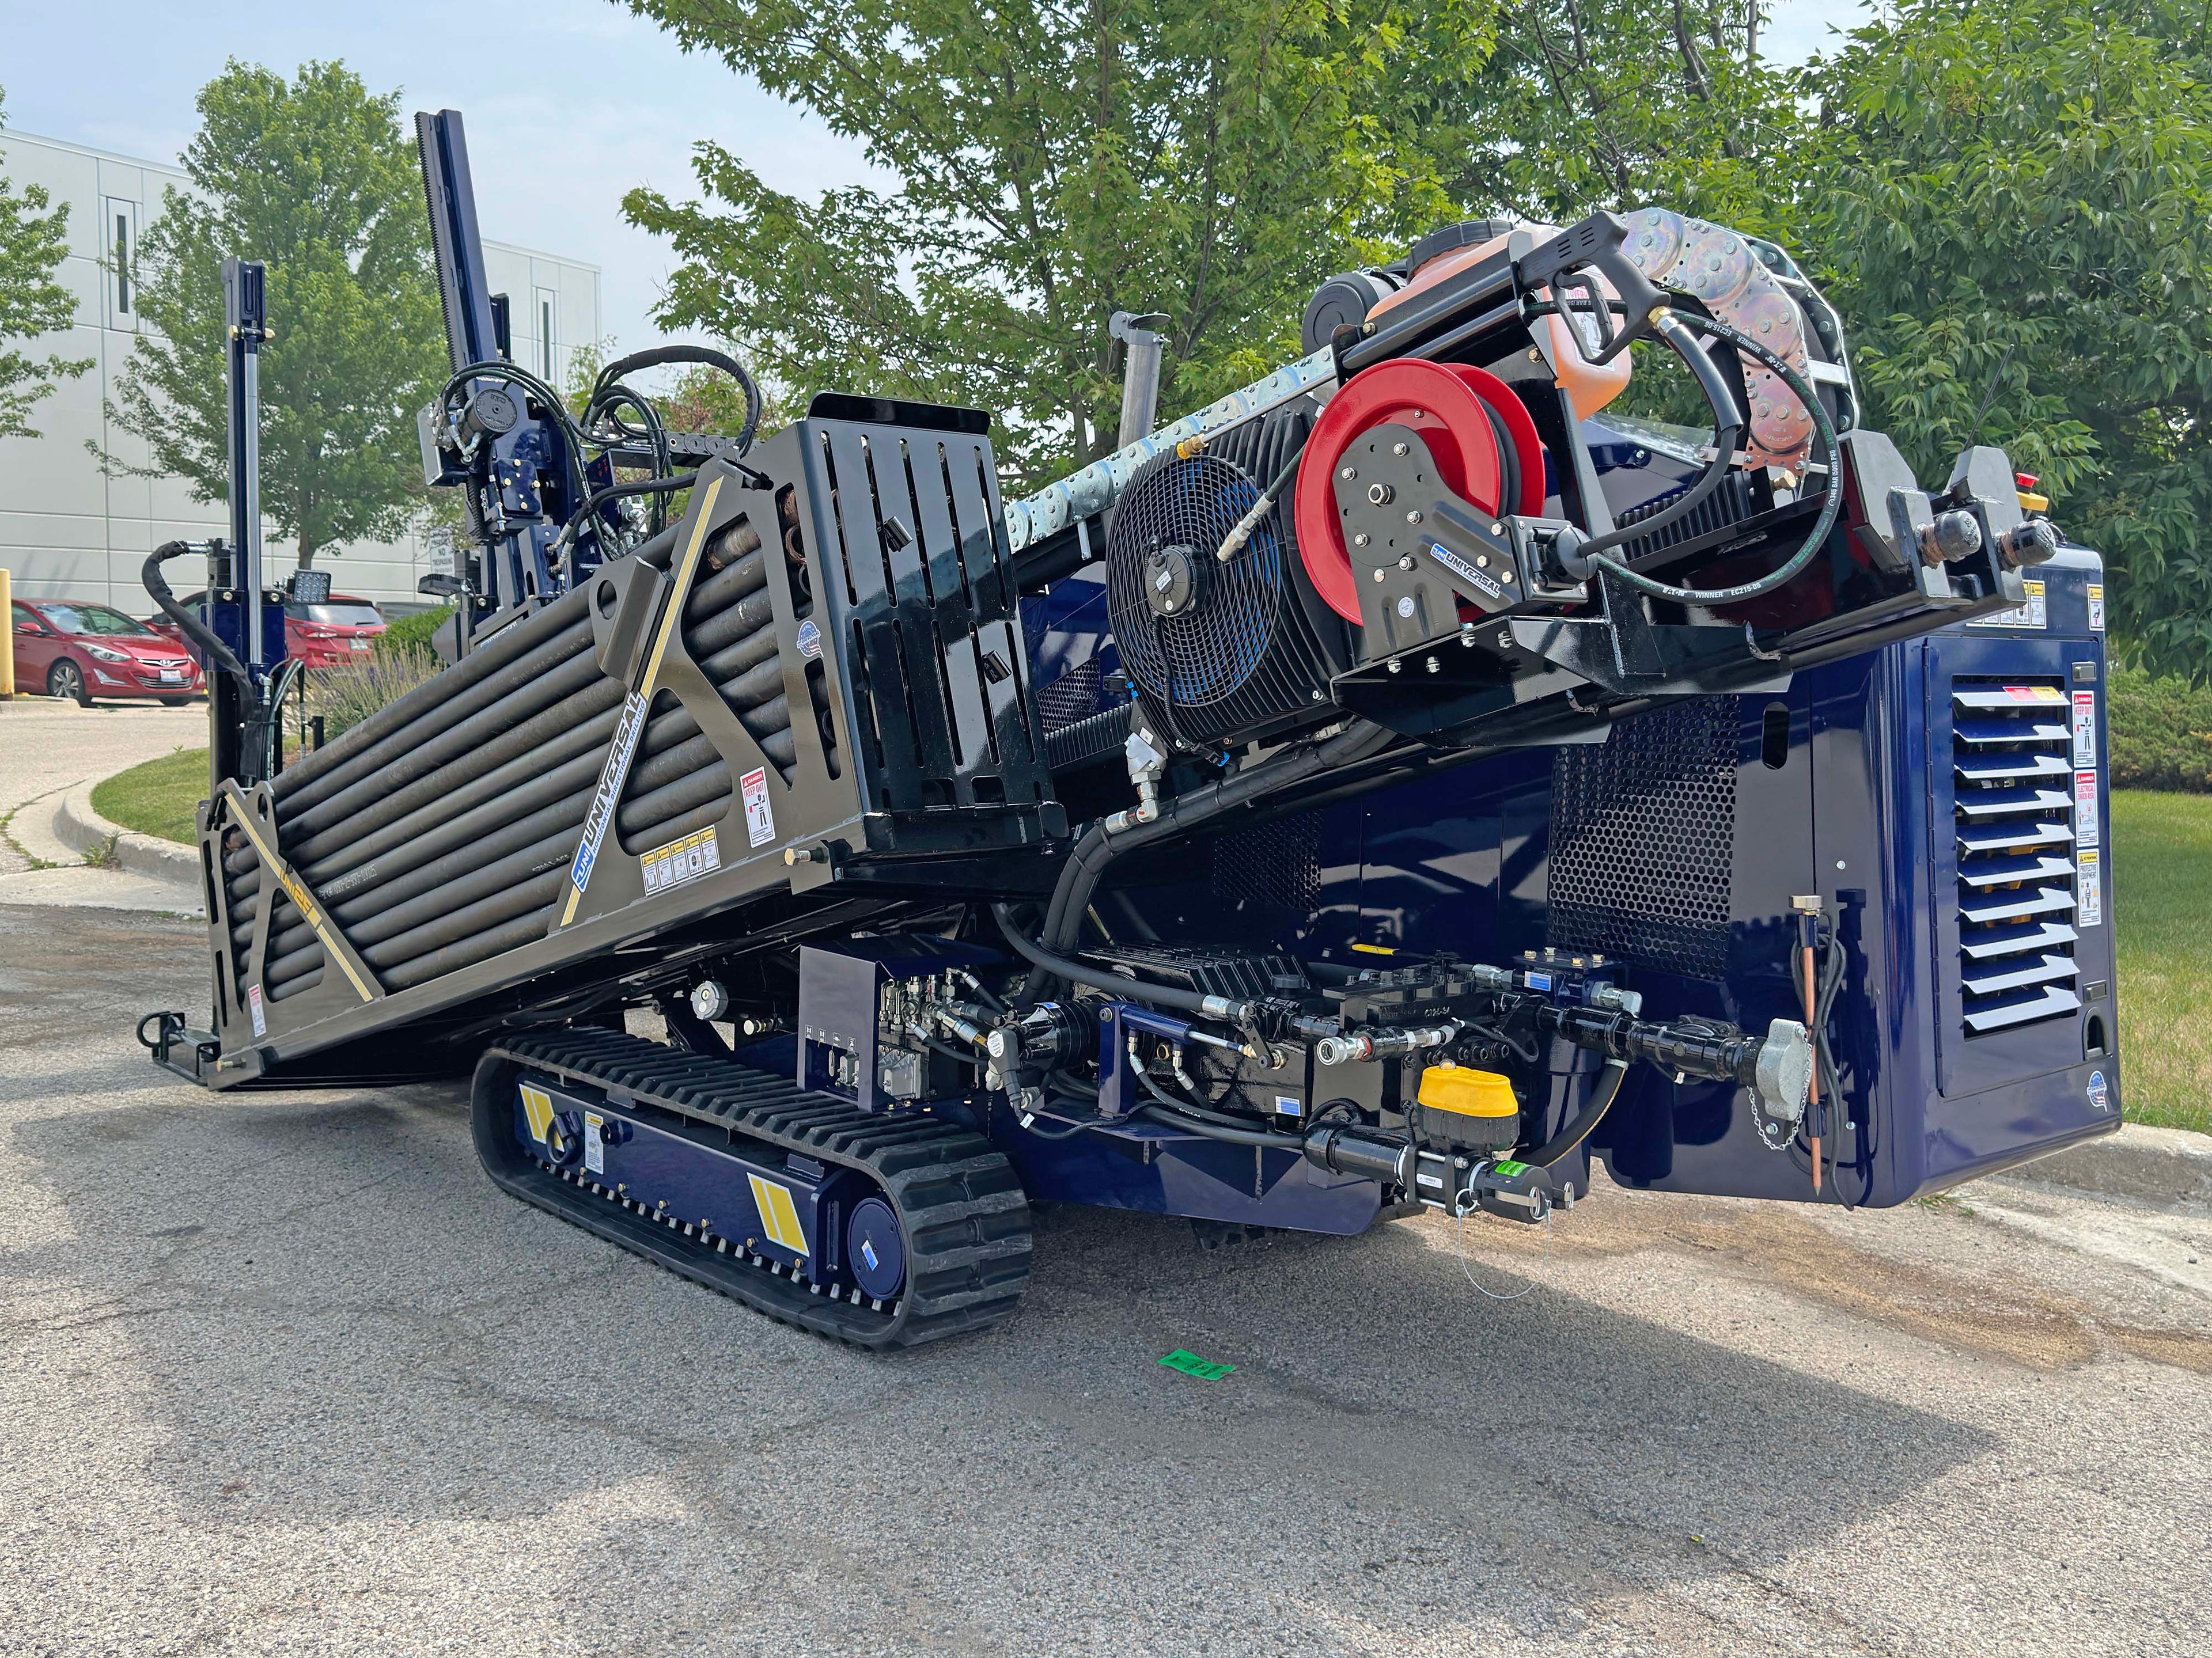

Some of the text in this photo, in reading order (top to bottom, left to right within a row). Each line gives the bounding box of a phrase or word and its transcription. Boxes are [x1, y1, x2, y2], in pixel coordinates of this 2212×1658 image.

[1704, 320, 1732, 337] EC215-06
[1737, 335, 1762, 354] WINNER
[438, 548, 445, 556] NO
[1433, 548, 1445, 559] UNI
[1445, 553, 1499, 594] UNIVERSAL
[1463, 572, 1483, 589] DIRECTIONAL
[1731, 582, 1762, 596] EC215-06
[2075, 707, 2084, 715] KEEP
[584, 694, 641, 847] UNIVERSAL
[593, 701, 645, 854] HORIZONTAL DIRECTIONAL DRILLING
[748, 773, 763, 784] DANGER
[745, 782, 764, 798] KEEP OUT
[2077, 784, 2094, 792] ELECTRICAL
[576, 848, 590, 880] UNI
[2080, 864, 2097, 872] PROTECTIVE
[2080, 872, 2097, 880] EQUIPMENT
